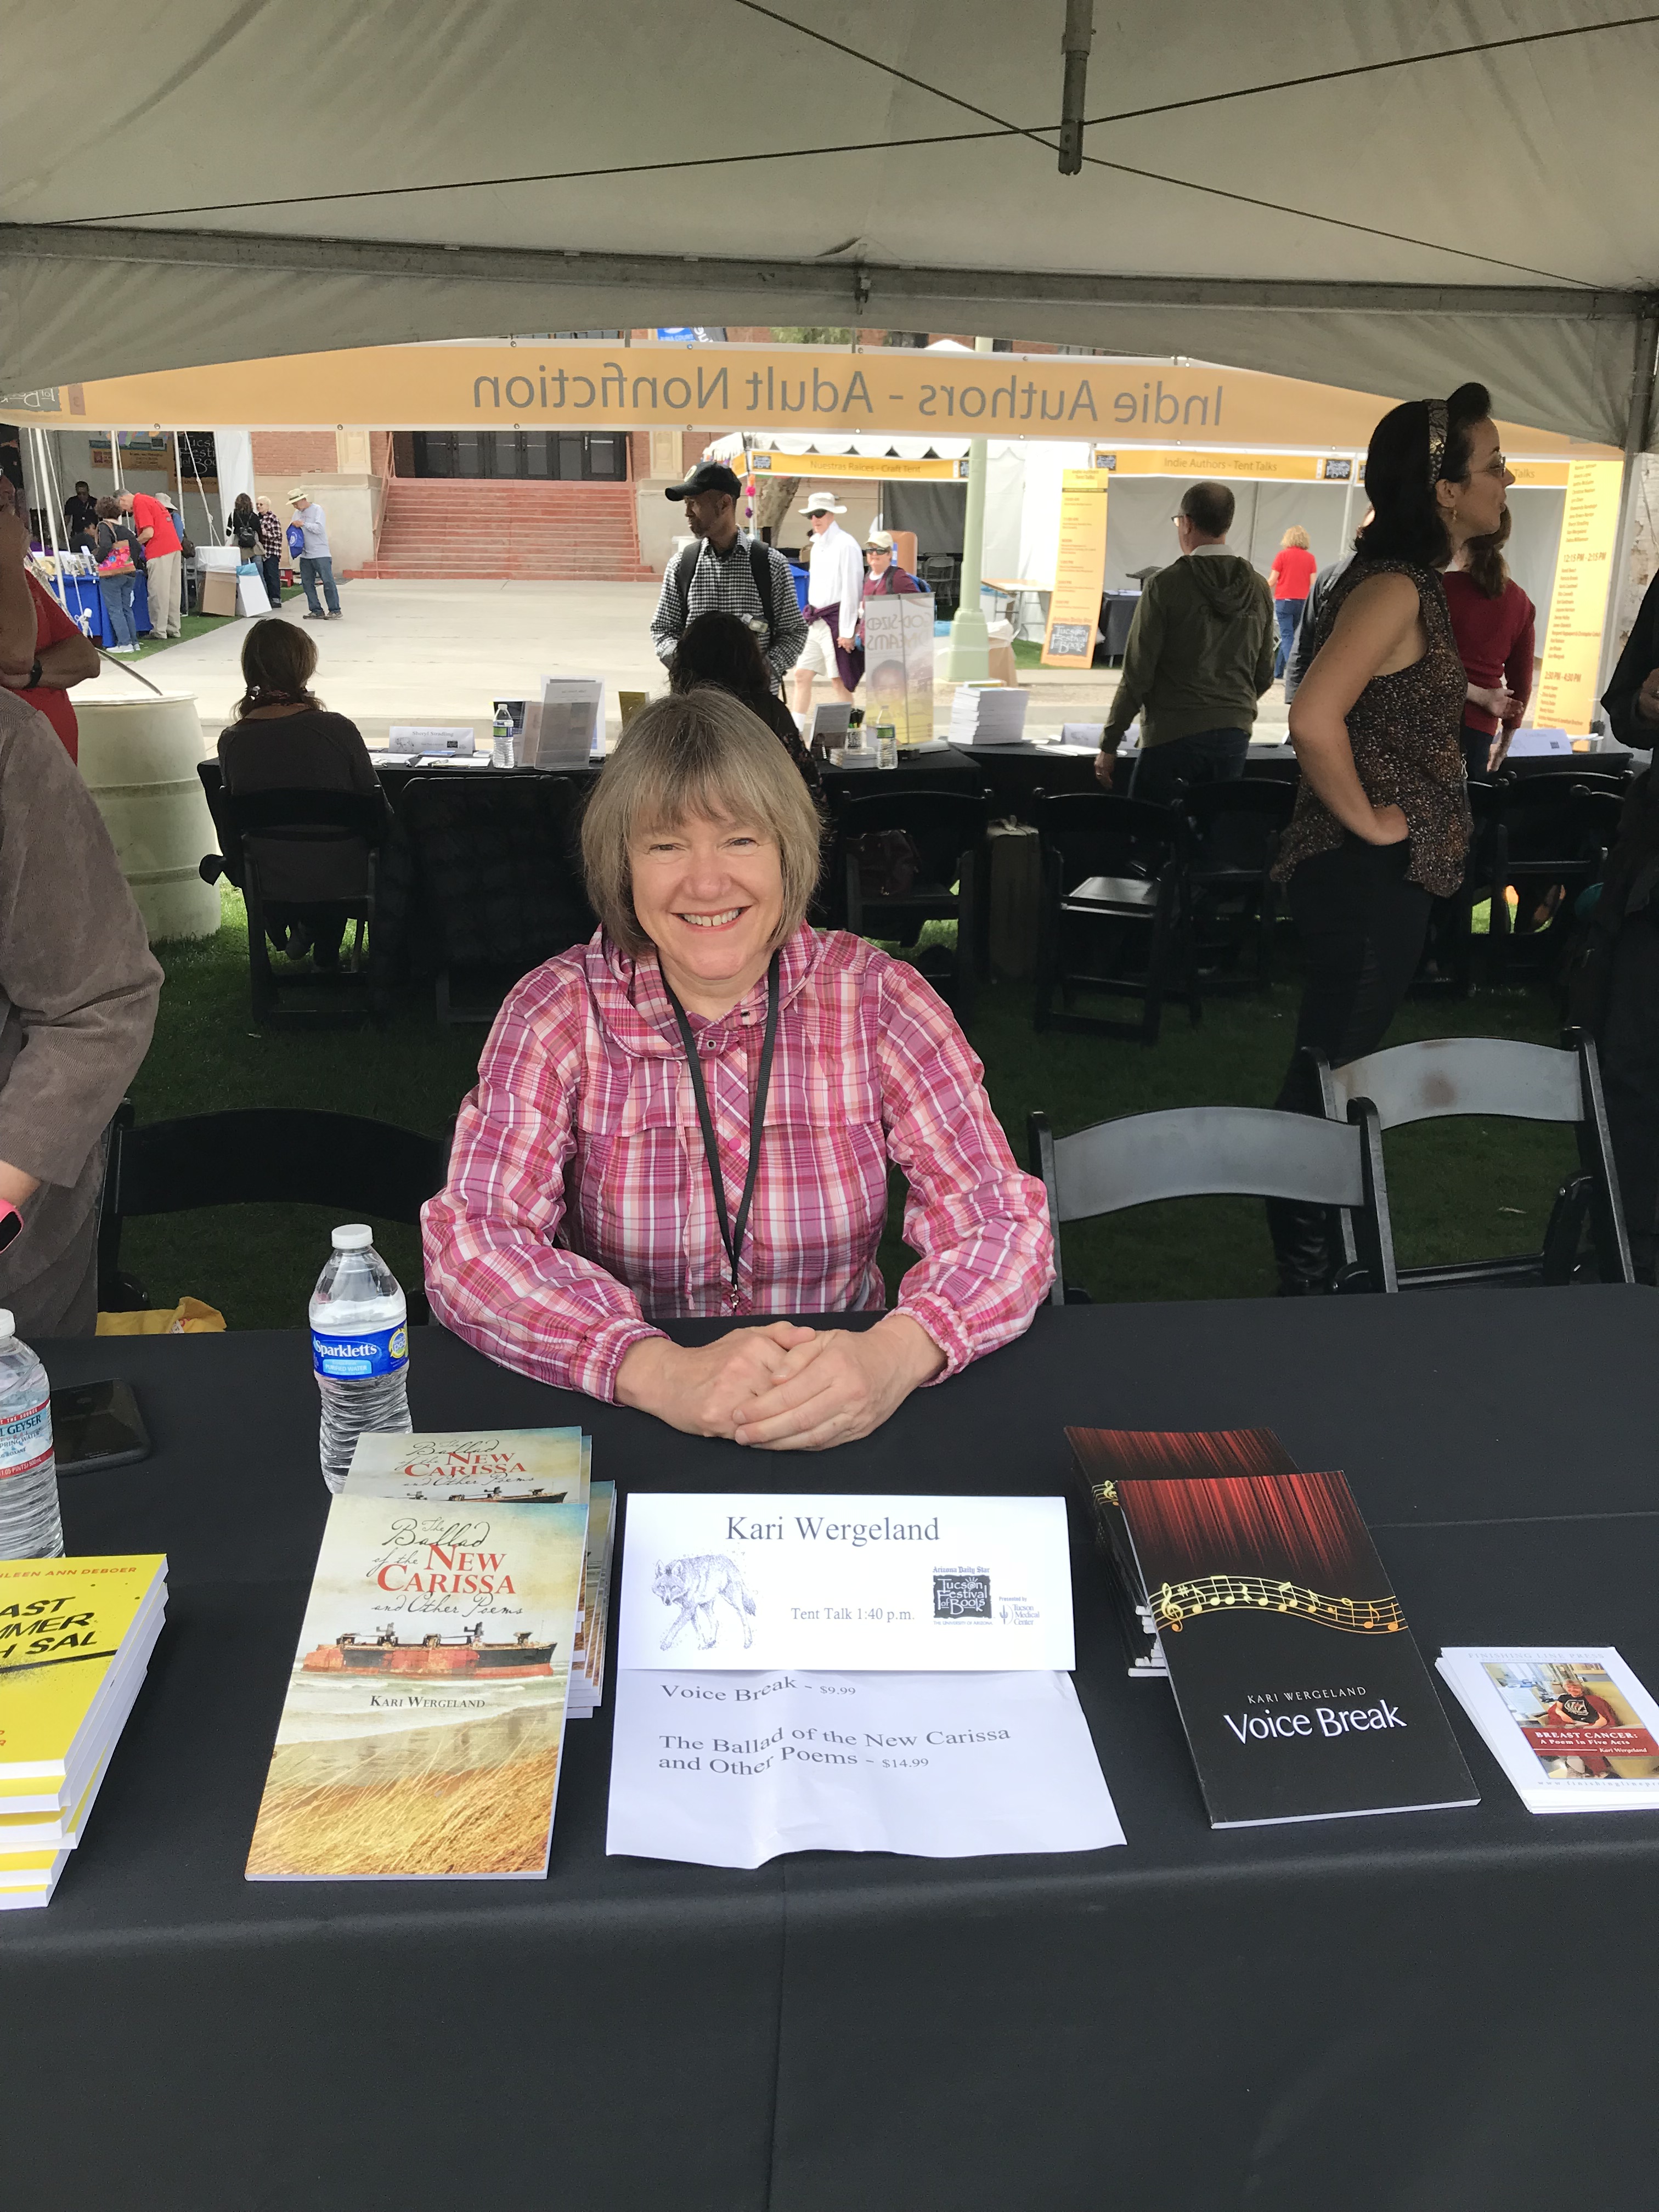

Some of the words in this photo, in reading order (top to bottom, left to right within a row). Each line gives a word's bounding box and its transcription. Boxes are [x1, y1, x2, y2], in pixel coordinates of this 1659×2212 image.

[1164, 457, 1188, 467] Indie
[1189, 458, 1226, 470] Authors
[1233, 460, 1254, 471] Tent
[1255, 461, 1278, 472] Talks
[1513, 468, 1536, 478] Talks
[315, 1340, 377, 1357] Sparkletts
[7, 1414, 42, 1435] GEYSER
[20, 1430, 41, 1443] WATER
[439, 1439, 460, 1448] The
[405, 1439, 500, 1456] Ballad
[394, 1455, 421, 1471] of
[420, 1456, 439, 1464] the
[444, 1451, 516, 1465] NEW
[404, 1462, 527, 1477] CARISSA
[402, 1477, 432, 1486] and
[432, 1474, 479, 1486] Other
[481, 1471, 535, 1486] Poems
[381, 1517, 490, 1547] Ballad
[421, 1516, 445, 1532] The
[725, 1516, 785, 1540] Kari
[794, 1516, 941, 1547] Wergeland
[366, 1547, 398, 1578] of
[393, 1550, 419, 1565] the
[423, 1543, 507, 1572] NEW
[81, 1567, 137, 1575] DEBOER
[377, 1564, 517, 1594] CARISSA
[958, 1566, 975, 1575] Daily
[937, 1577, 983, 1594] Tucson
[371, 1594, 407, 1612] and
[407, 1591, 459, 1613] Other
[461, 1592, 524, 1617] Poems
[936, 1584, 988, 1610] Festival
[940, 1597, 950, 1609] of
[791, 1607, 820, 1620] Tent
[823, 1607, 853, 1620] Talk
[857, 1607, 883, 1620] 1:40
[886, 1610, 916, 1623] p.m.
[950, 1598, 986, 1615] Books
[25, 1630, 98, 1655] SAL
[660, 1685, 727, 1701] Voice
[733, 1675, 799, 1702] Break
[820, 1685, 856, 1695] $9.99
[1247, 1693, 1279, 1705] KARI
[1283, 1686, 1367, 1701] WERGELAND
[370, 1695, 404, 1707] KARI
[408, 1696, 486, 1708] WERGELAND
[1223, 1708, 1313, 1745] Voice
[1315, 1699, 1408, 1737] Break
[659, 1735, 704, 1750] The
[712, 1726, 785, 1754] Ballad
[792, 1728, 818, 1741] of
[822, 1730, 857, 1746] the
[863, 1733, 918, 1748] New
[926, 1729, 1012, 1745] Carissa
[658, 1757, 702, 1770] and
[709, 1756, 774, 1776] Other
[780, 1746, 859, 1765] Poems
[882, 1758, 929, 1769] $14.99
